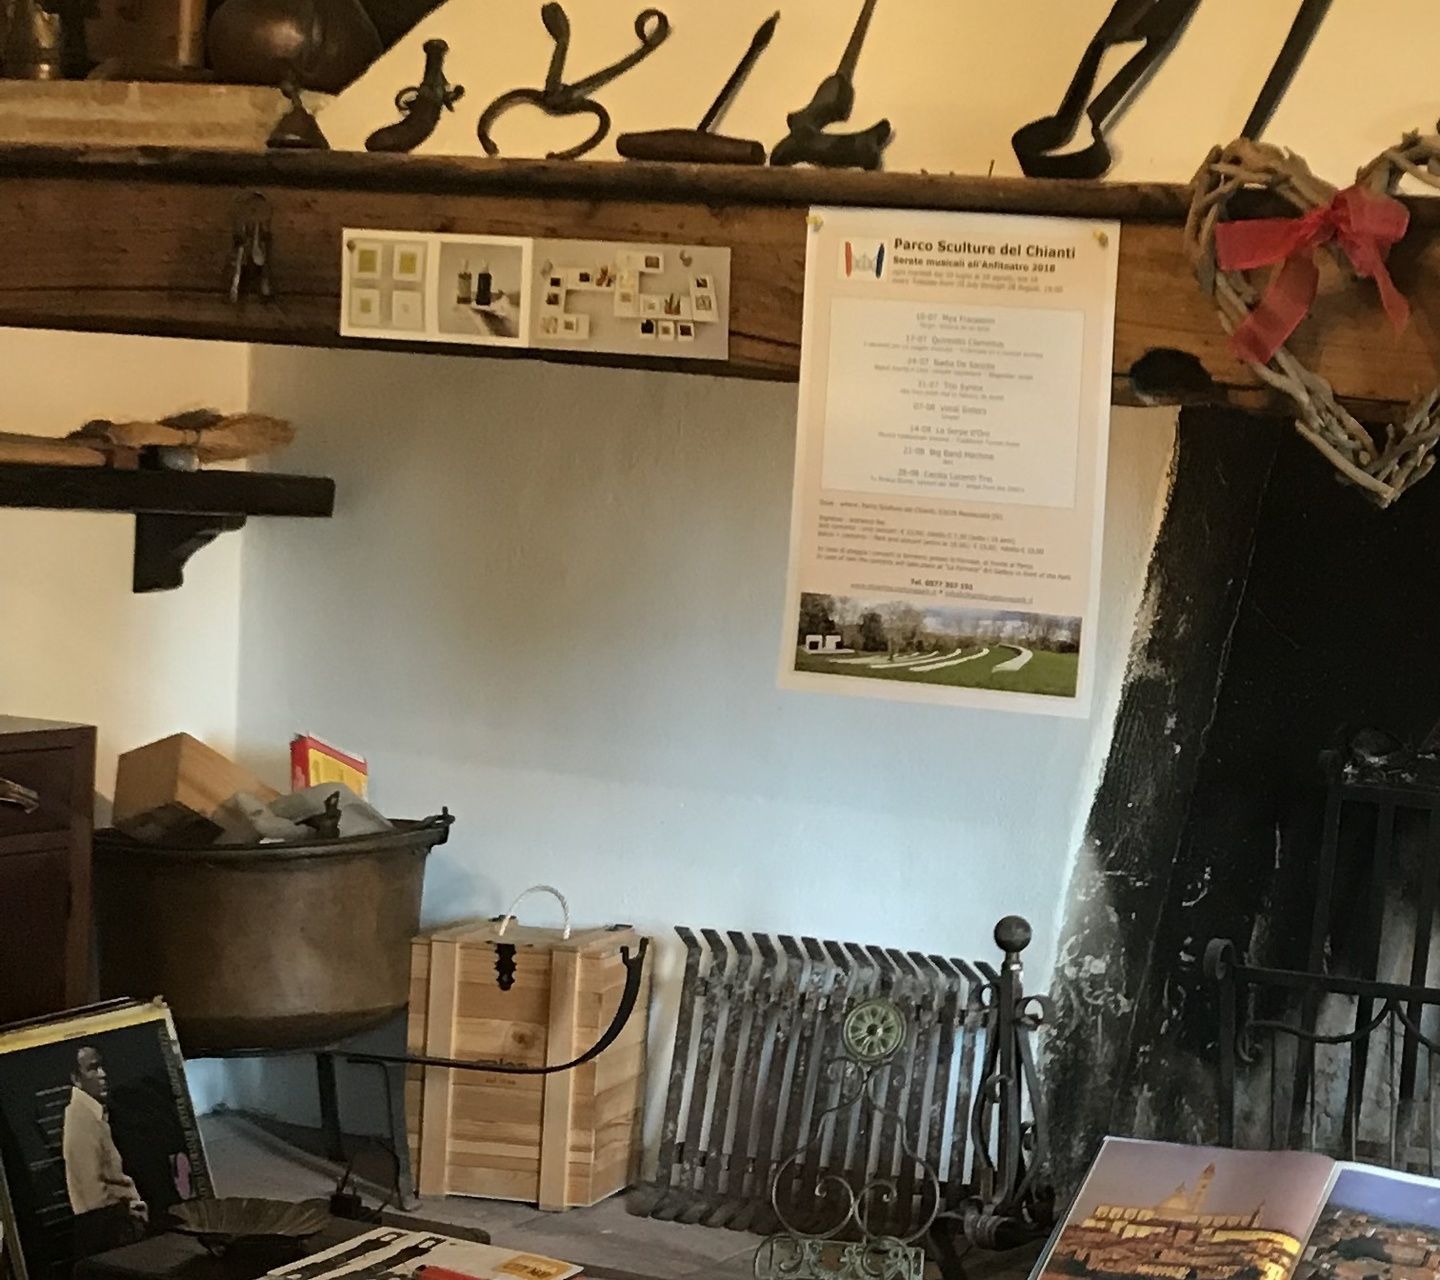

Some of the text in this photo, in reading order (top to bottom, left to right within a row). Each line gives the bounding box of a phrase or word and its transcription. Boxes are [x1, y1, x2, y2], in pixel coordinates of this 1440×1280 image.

[894, 238, 1077, 260] Parco Sculture del Chianti
